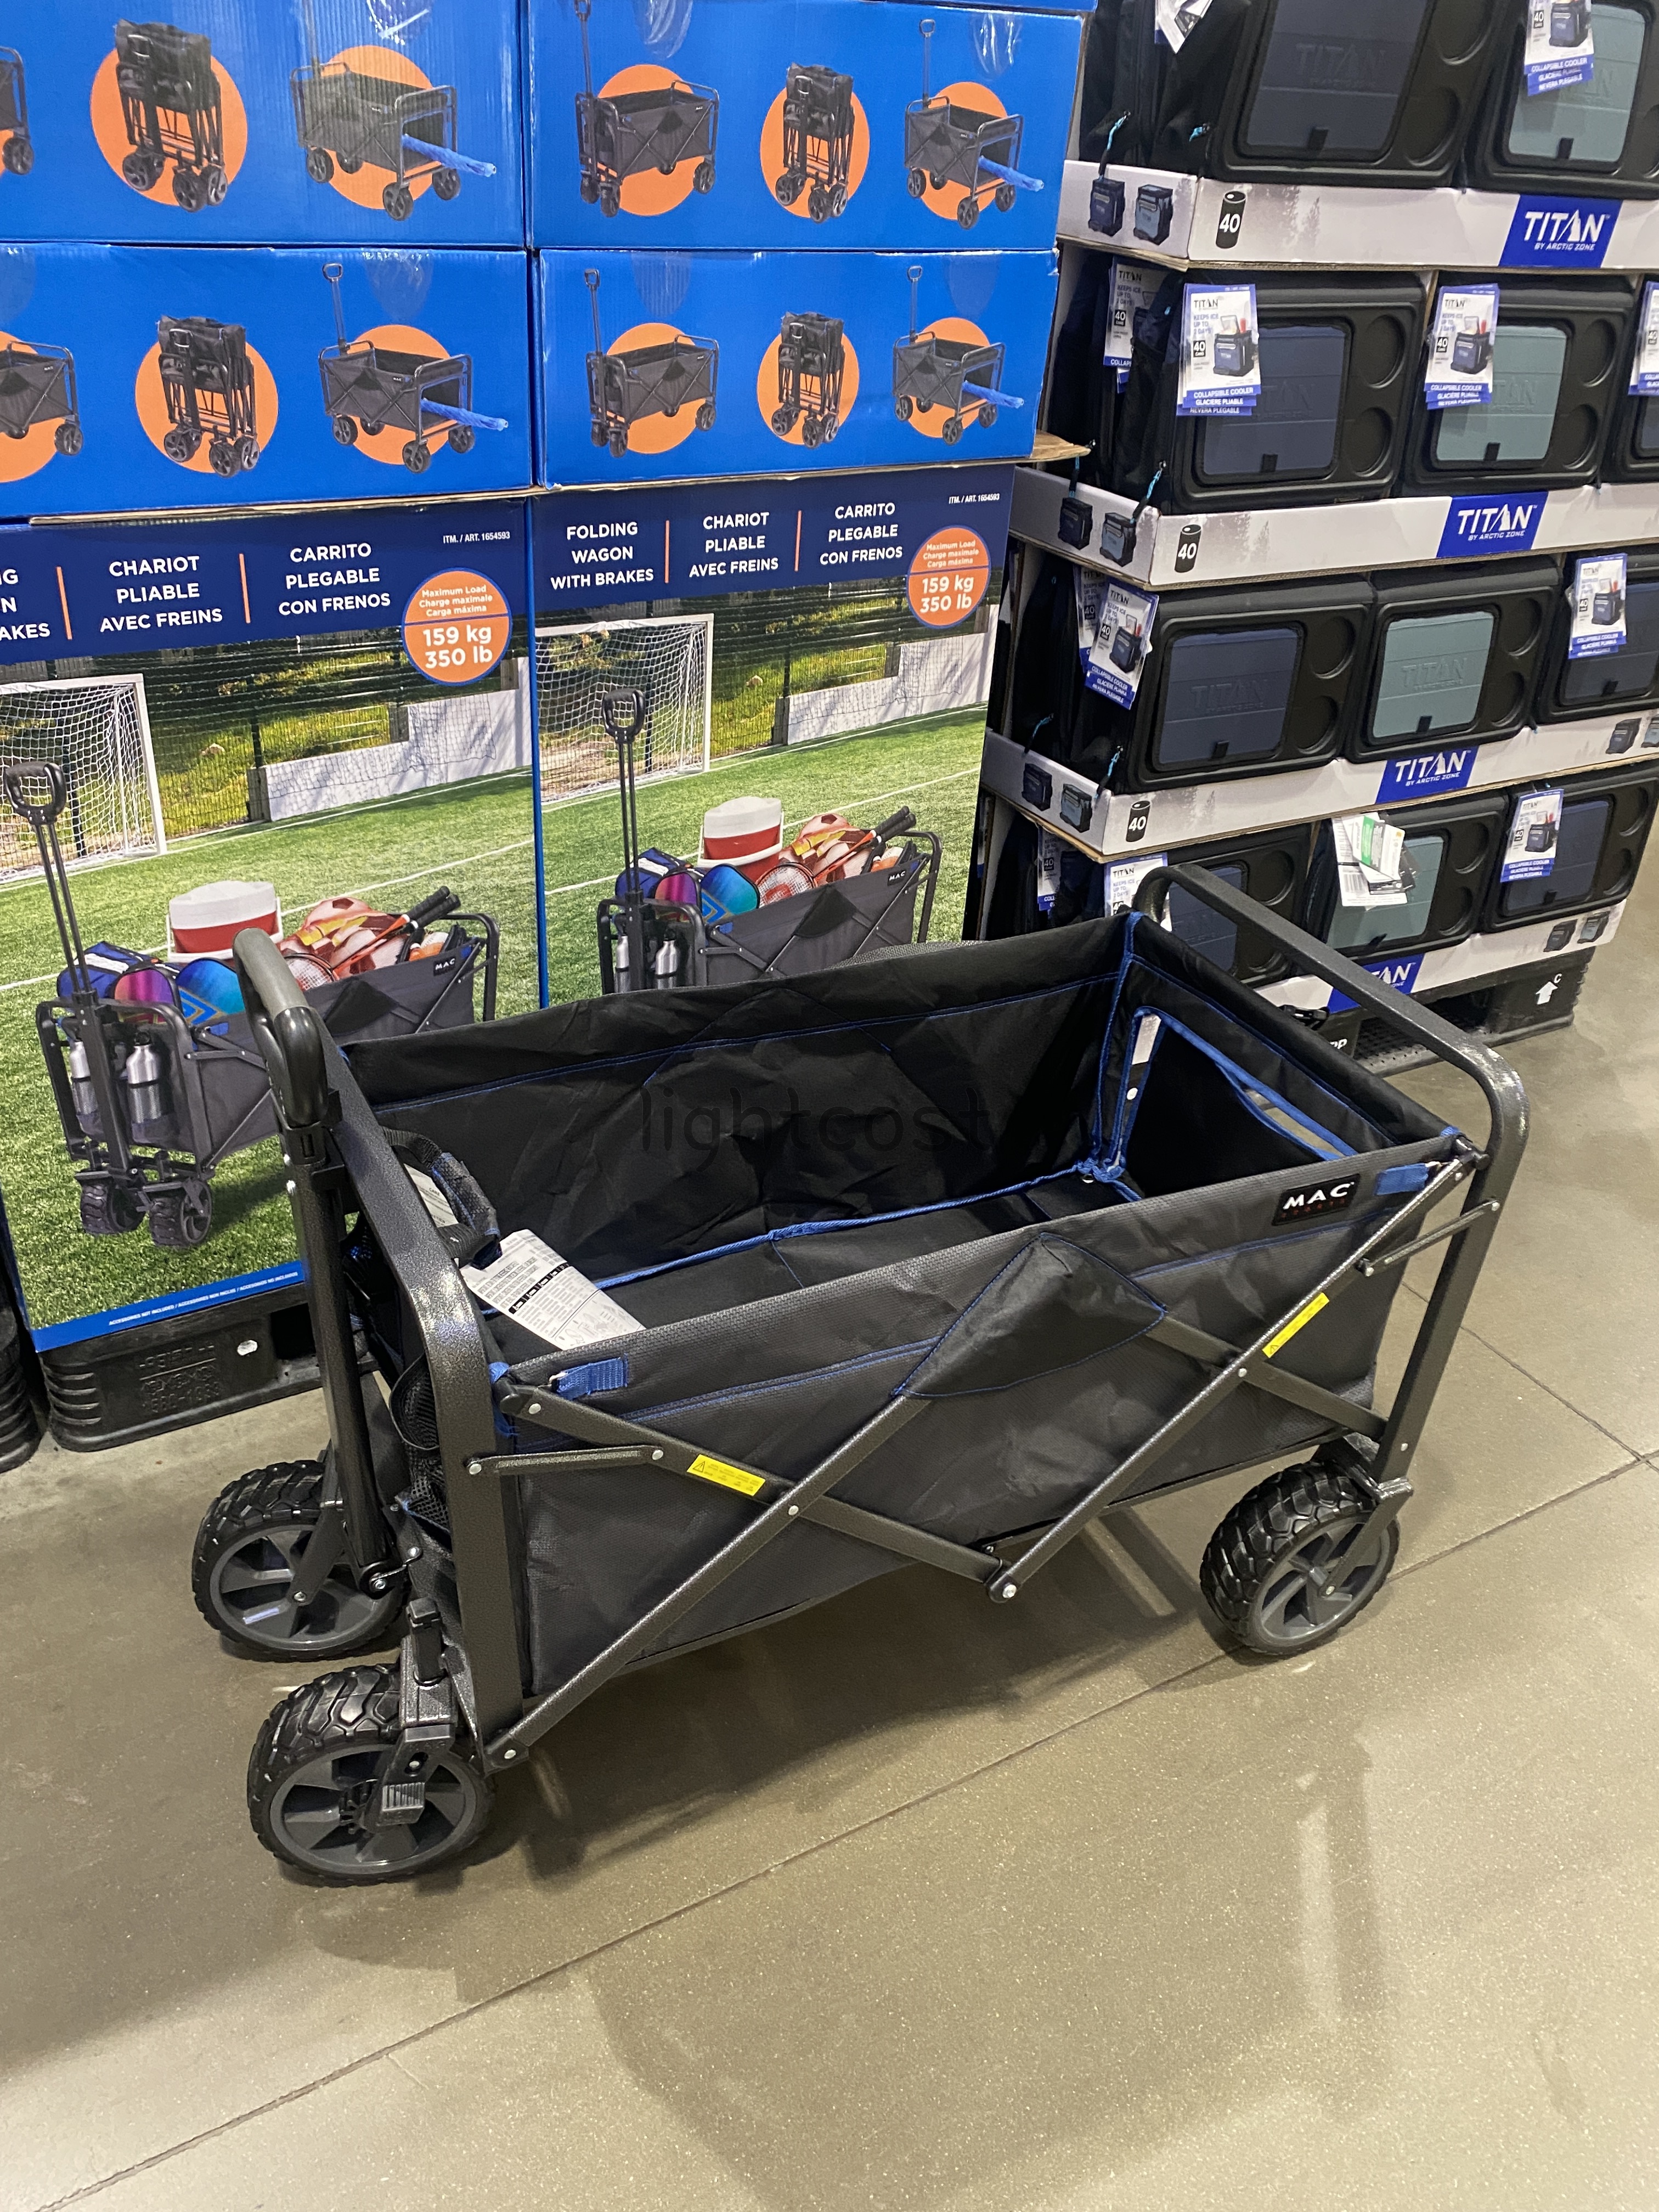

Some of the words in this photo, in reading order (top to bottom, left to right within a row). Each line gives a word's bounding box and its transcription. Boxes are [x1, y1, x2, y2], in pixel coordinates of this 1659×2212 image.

[1534, 12, 1544, 22] 40
[1564, 57, 1587, 66] COOLER
[1219, 213, 1240, 233] 40
[1524, 209, 1605, 242] TITAN
[1545, 242, 1573, 251] ARCTIC
[1119, 270, 1142, 282] TITAN
[1194, 298, 1218, 309] TITAN
[1444, 299, 1465, 308] TITAN
[1115, 311, 1125, 320] 40
[1193, 341, 1205, 352] 40
[1437, 337, 1448, 348] 40
[1193, 389, 1229, 398] COLLAPSIBLE
[1230, 387, 1254, 395] COOLER
[835, 503, 895, 519] CARRITO
[703, 512, 769, 530] CHARIOT
[1458, 504, 1533, 535] TITAN
[443, 533, 458, 544] ITM.
[465, 532, 480, 542] ART.
[481, 531, 510, 541] 1654593
[567, 522, 638, 540] FOLDING
[828, 524, 899, 543] PLEGABLE
[705, 535, 765, 553] PLIABLE
[927, 543, 958, 551] Maximum
[959, 540, 976, 548] Load
[1177, 543, 1197, 560] 40
[290, 542, 372, 563] CARRITO
[571, 546, 633, 564] WAGON
[820, 551, 848, 566] CON
[851, 546, 903, 563] FRENOS
[923, 551, 946, 560] Charge
[948, 549, 979, 557] maximale
[109, 555, 200, 577] CHARIOT
[689, 561, 727, 578] AVEC
[730, 557, 779, 574] FREINS
[927, 560, 946, 568] Carga
[948, 557, 973, 566] máxima
[285, 567, 380, 590] PLEGABLE
[550, 574, 591, 590] WITH
[595, 568, 654, 586] BRAKES
[922, 576, 950, 594] 159
[954, 574, 974, 592] kg
[116, 582, 200, 604] PLIABLE
[422, 586, 462, 598] Maximum
[465, 584, 487, 594] Load
[1110, 590, 1129, 605] TITAN
[278, 599, 317, 616] CON
[322, 593, 391, 613] FRENOS
[419, 598, 449, 608] Charge
[452, 594, 493, 604] maximale
[919, 595, 952, 613] 350
[956, 592, 972, 610] lb
[426, 607, 452, 617] Carga
[454, 605, 487, 613] máxima
[1085, 606, 1095, 614] 40
[100, 614, 151, 633] AVEC
[157, 608, 223, 629] FREINS
[422, 628, 459, 646] 159
[466, 625, 492, 644] kg
[1102, 624, 1110, 636] 40
[425, 651, 466, 669] 350
[473, 646, 493, 664] lb
[1114, 678, 1128, 690] COOLER
[1395, 750, 1467, 782] TITAN
[1415, 776, 1440, 785] ARCTIC
[1441, 772, 1460, 780] ZONE
[1128, 816, 1147, 831] 40
[889, 871, 906, 881] MAC
[1113, 867, 1135, 878] TITAN
[435, 958, 455, 970] MAC
[1554, 973, 1562, 984] C
[1283, 1182, 1353, 1210] MAC
